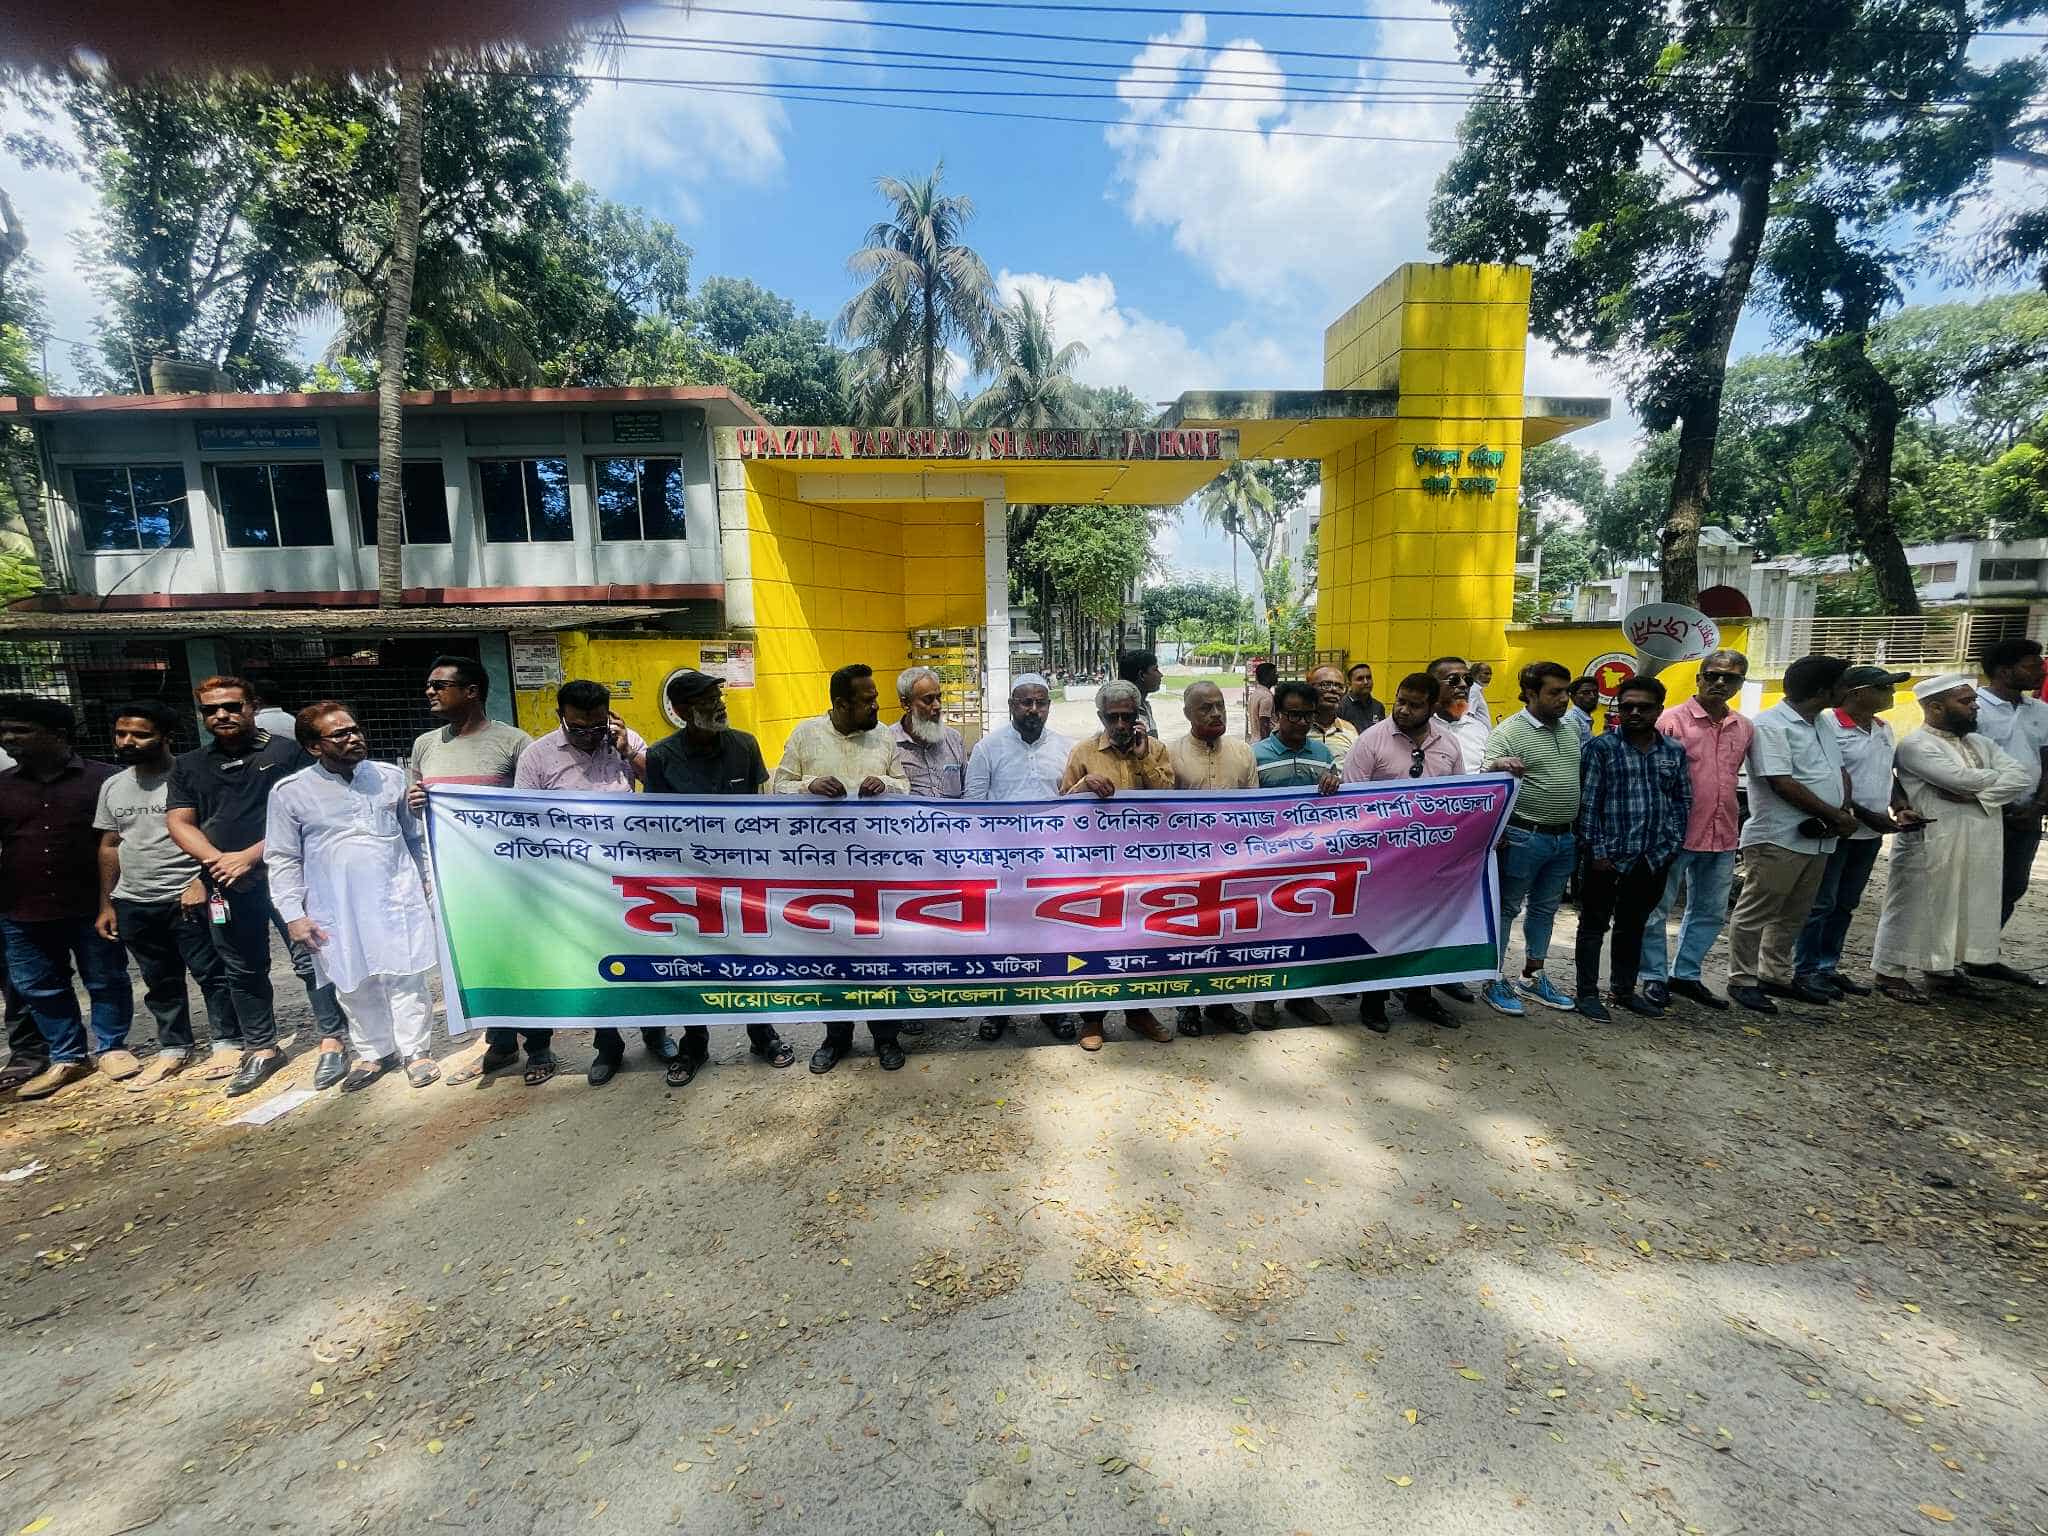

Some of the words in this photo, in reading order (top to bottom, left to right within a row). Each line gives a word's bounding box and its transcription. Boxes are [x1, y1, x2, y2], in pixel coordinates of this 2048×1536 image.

[736, 429, 844, 456] UPAZILA
[990, 429, 1101, 456] SHARSHA
[547, 808, 616, 831] শিকার
[624, 814, 727, 834] বেনাপোল
[734, 815, 779, 836] প্রেস
[788, 815, 858, 836] ক্লাবের
[865, 811, 972, 837] সাংগঠনিক
[979, 814, 1065, 832] সম্পাদক
[1072, 815, 1090, 831] ও
[1095, 808, 1161, 831] দৈনিক
[1168, 811, 1217, 829] লোক
[1222, 810, 1275, 828] সমাজ
[1282, 802, 1360, 826] পত্রিকার
[1364, 796, 1413, 818] শার্শা
[1415, 793, 1495, 815] উপজেলা
[494, 837, 591, 861] প্রতিনিধি
[600, 841, 683, 863] মনিরুল
[690, 843, 772, 866] ইসলাম
[781, 844, 837, 867] মনির
[847, 844, 926, 867] বিরুদ্ধে
[933, 847, 1046, 870] ষড়যন্ত্রমূলক
[1053, 844, 1117, 863] মামলা
[1124, 842, 1212, 861] প্রত্যাহার
[1220, 841, 1239, 856] ও
[1243, 832, 1315, 857] নিঃশর্ত
[1321, 829, 1381, 855] মুক্তির
[1385, 823, 1457, 848] দাবীতে
[612, 874, 1000, 938] মানব
[1027, 859, 1371, 940] বন্ধন
[651, 958, 711, 977] তারিখ-
[965, 960, 985, 975] ১১
[992, 956, 1042, 973] ঘটিকা
[1167, 947, 1221, 966] শার্শা
[840, 986, 900, 1005] শার্শা
[907, 985, 1008, 1004] উপজেলা
[1014, 980, 1122, 1001] সাংবাদিক
